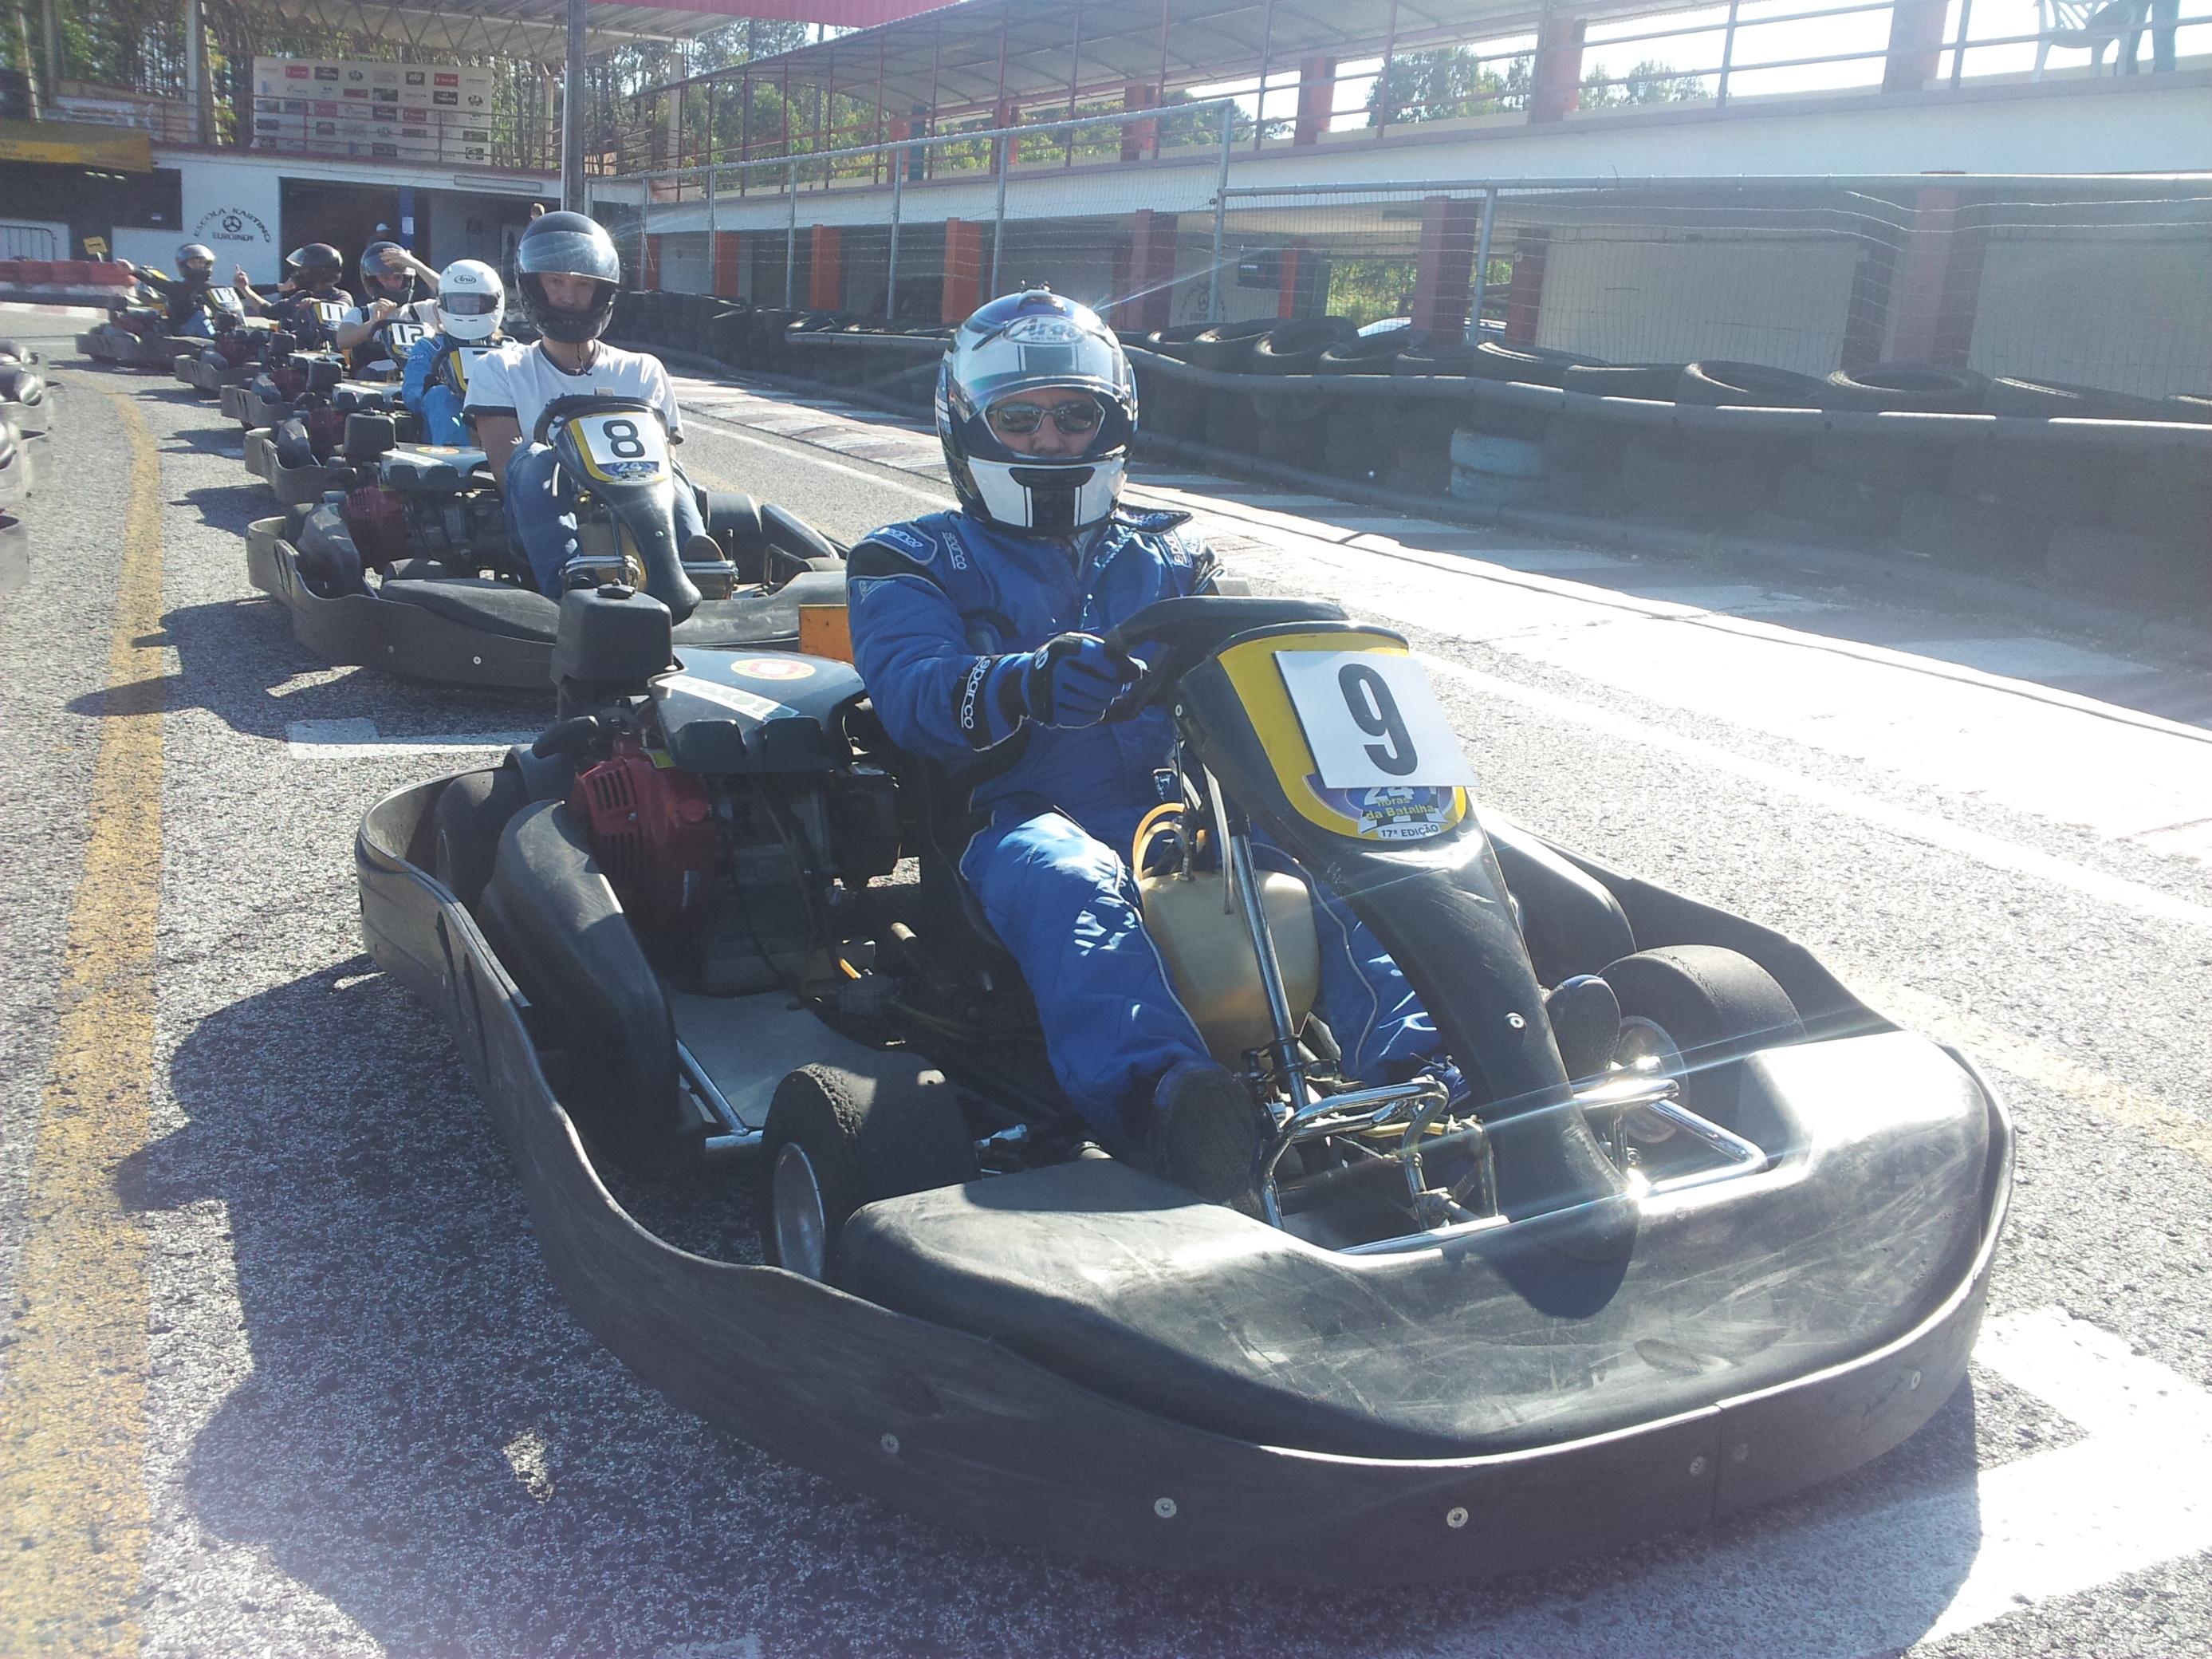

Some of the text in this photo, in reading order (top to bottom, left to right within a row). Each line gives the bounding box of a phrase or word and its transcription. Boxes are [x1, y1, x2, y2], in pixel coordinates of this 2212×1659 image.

[194, 207, 272, 243] ESCOLA KARTING
[215, 288, 235, 301] 13
[398, 325, 424, 343] 12
[603, 420, 646, 458] 8
[1337, 664, 1419, 776] 9
[1377, 795, 1411, 807] horas
[1366, 803, 1435, 821] da Batalha
[1401, 823, 1439, 837] EDIÇÃO
